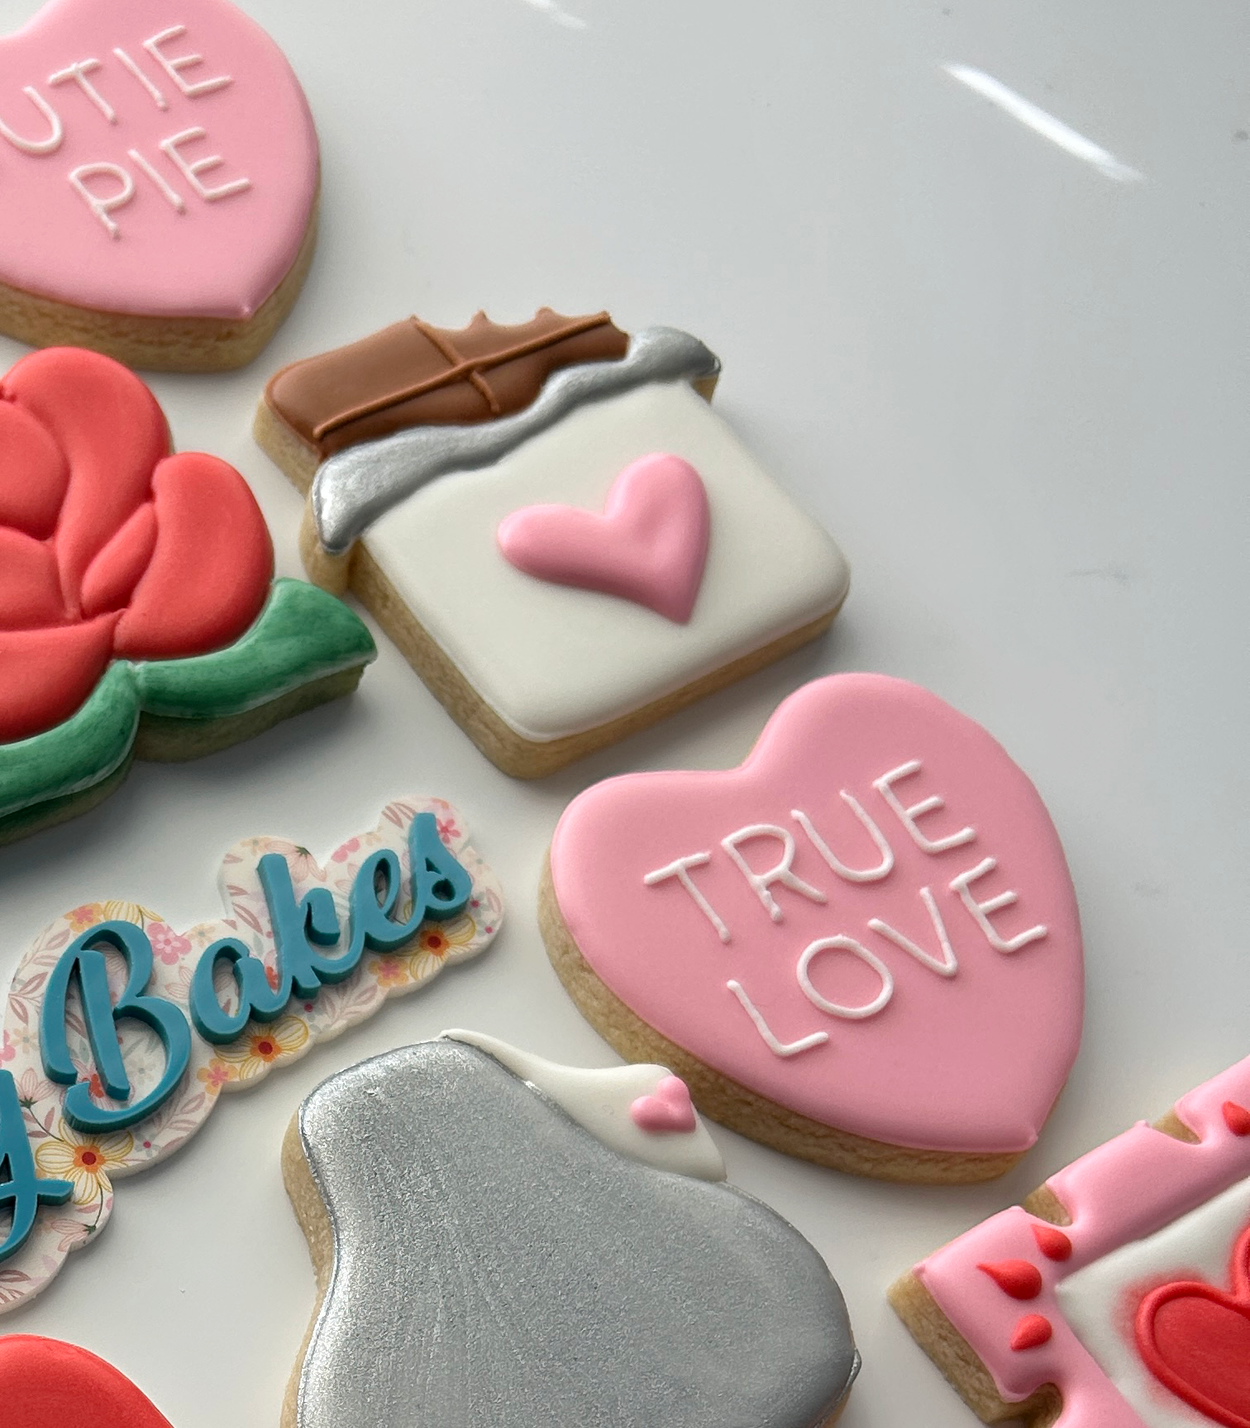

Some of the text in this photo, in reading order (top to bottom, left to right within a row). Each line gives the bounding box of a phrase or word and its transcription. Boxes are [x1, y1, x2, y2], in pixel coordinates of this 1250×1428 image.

[67, 126, 251, 238] PIE
[644, 760, 978, 943] TRUE
[38, 812, 474, 1134] Bakes
[726, 857, 1048, 1058] LOVE
